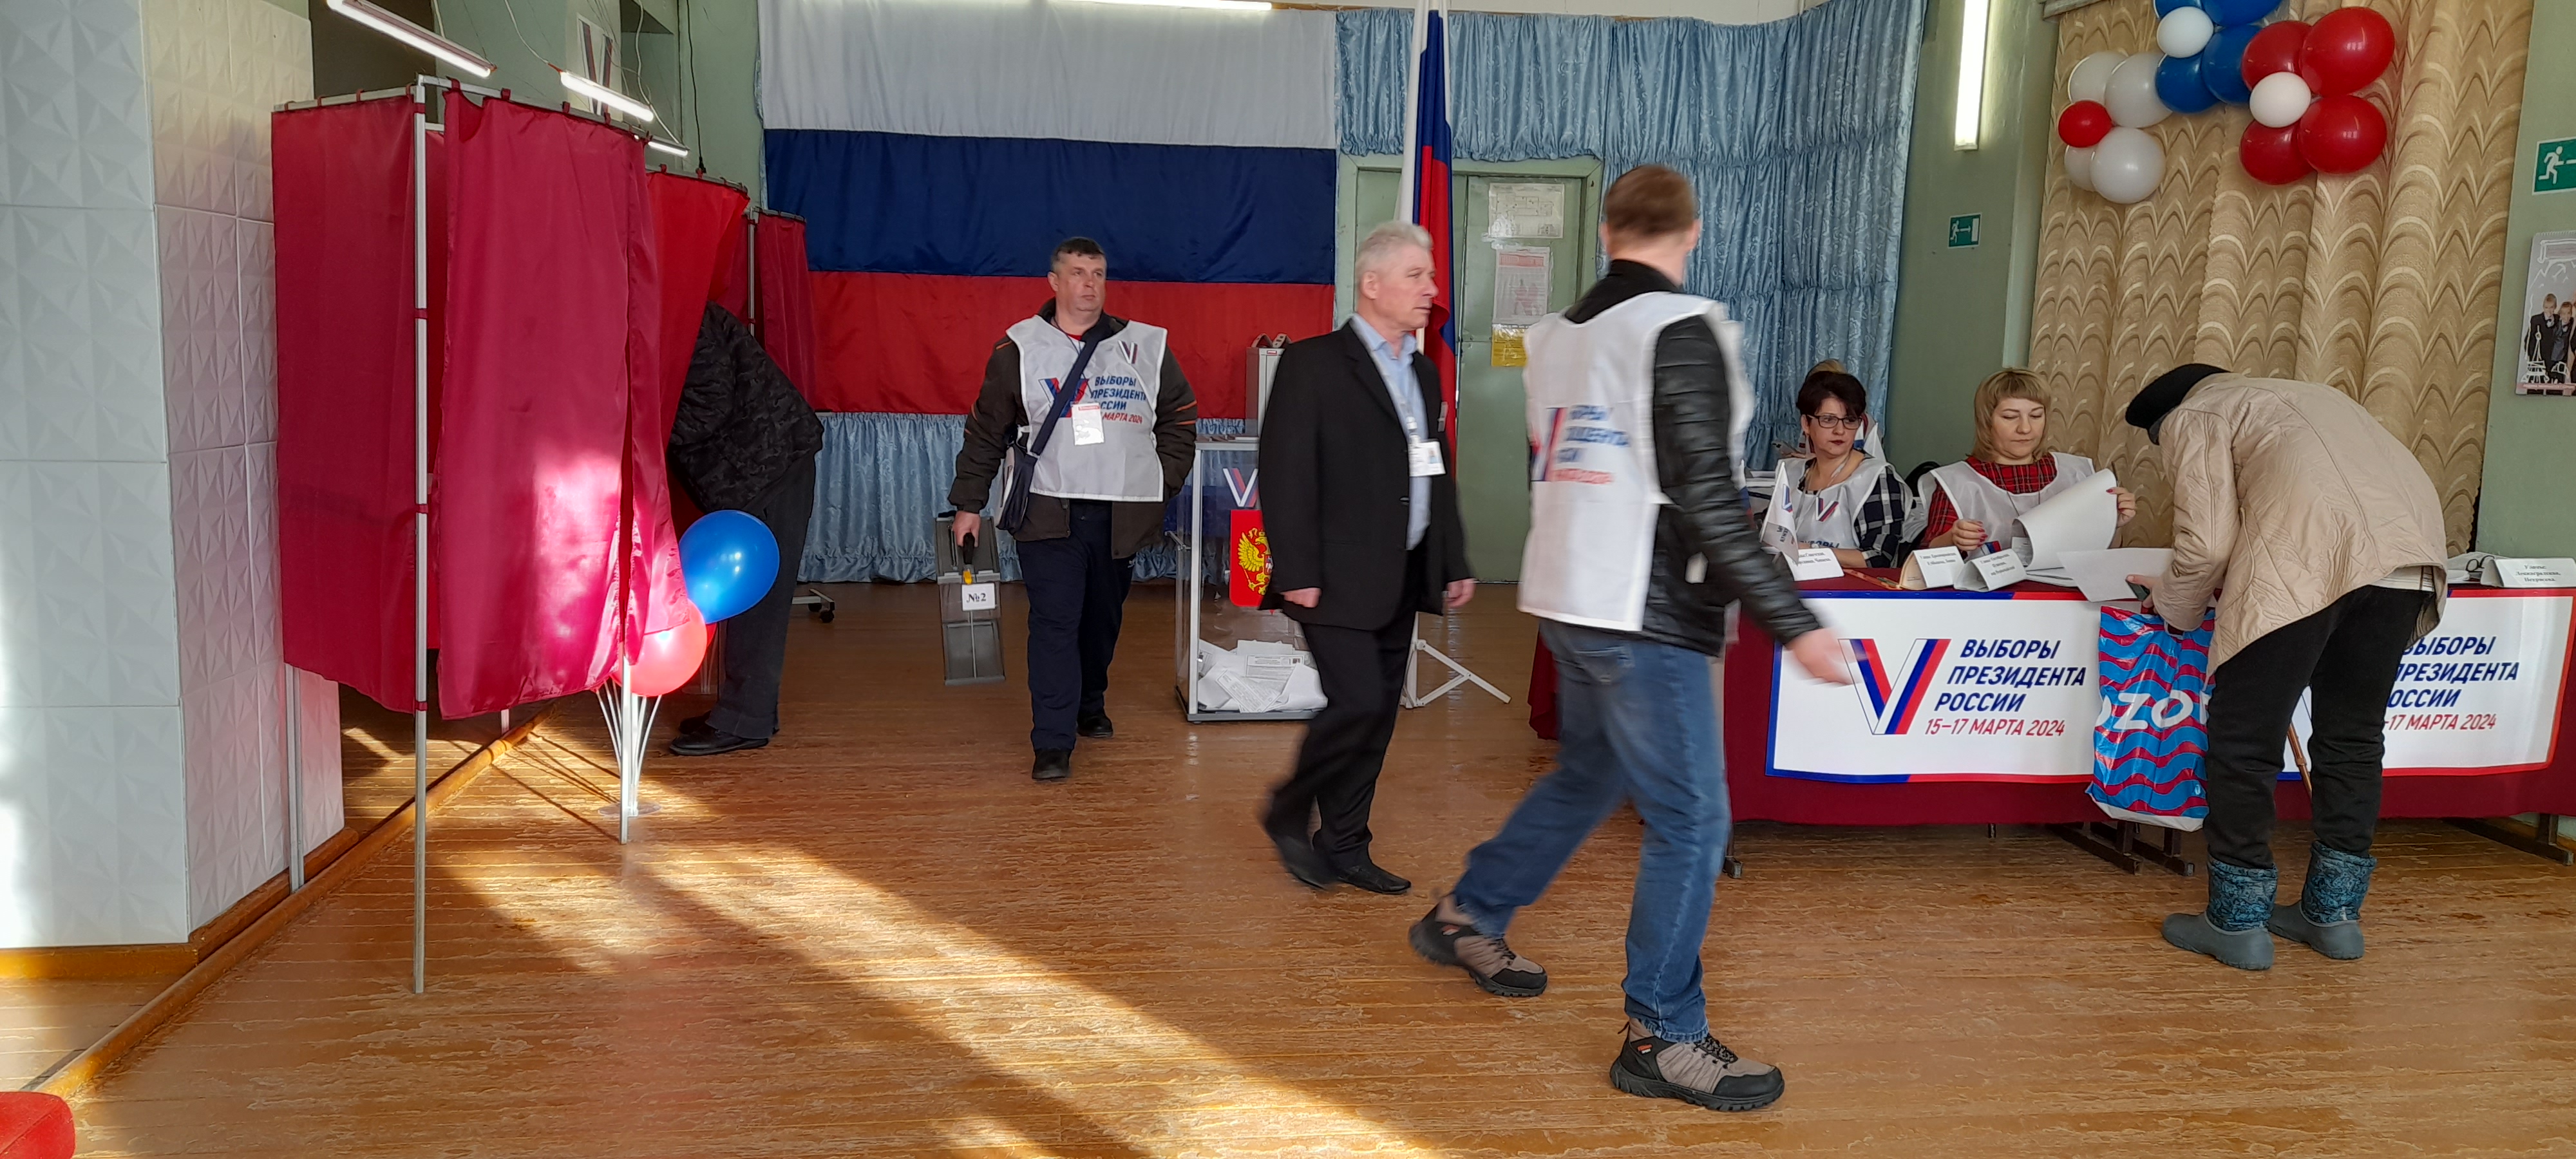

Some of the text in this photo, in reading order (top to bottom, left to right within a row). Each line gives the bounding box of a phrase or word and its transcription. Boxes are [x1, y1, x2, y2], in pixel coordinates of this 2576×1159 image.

[1095, 375, 1137, 386] ВЫБОРЫ
[1128, 414, 1143, 424] 2024
[1960, 639, 2061, 659] ВЫБОРЫ
[1947, 666, 2087, 688] ПРЕЗИДЕНТА
[1934, 693, 2027, 712] РОССИИ
[2387, 689, 2462, 708] ОССИИ
[1965, 719, 2025, 736] МАРТА
[2026, 720, 2065, 736] 2024
[2405, 714, 2459, 730] МАРТА
[2459, 713, 2497, 730] 2024
